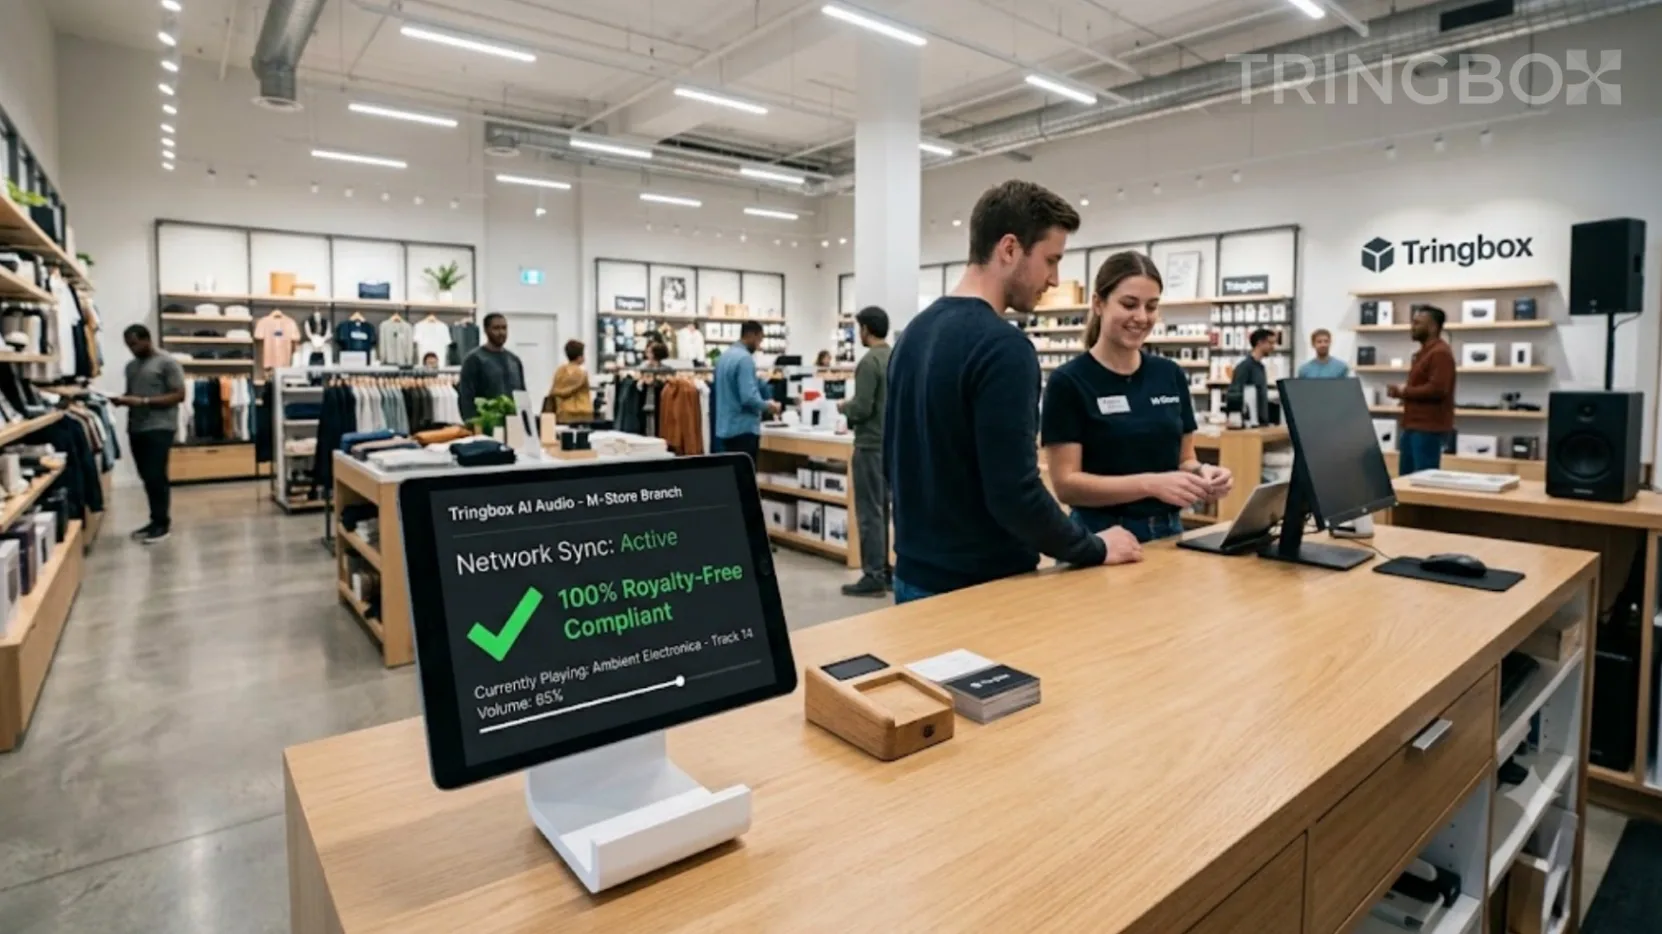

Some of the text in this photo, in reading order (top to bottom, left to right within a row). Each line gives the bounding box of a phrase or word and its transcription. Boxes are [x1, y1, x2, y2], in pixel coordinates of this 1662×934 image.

[1401, 234, 1534, 267] Tringbox
[448, 505, 514, 522] Tringbox
[518, 500, 532, 514] AI
[536, 497, 575, 512] Audio
[587, 491, 637, 507] M-Store
[641, 486, 682, 500] Branch
[456, 529, 678, 575] Network Sync: Active
[558, 563, 743, 610] 100% Royalty-Free
[563, 604, 673, 640] Compliant
[474, 674, 537, 700] Currently
[540, 663, 589, 686] Playing:
[592, 651, 640, 673] Ambient
[642, 640, 702, 662] Electronica
[711, 632, 741, 647] Track
[476, 696, 532, 721] Volume:
